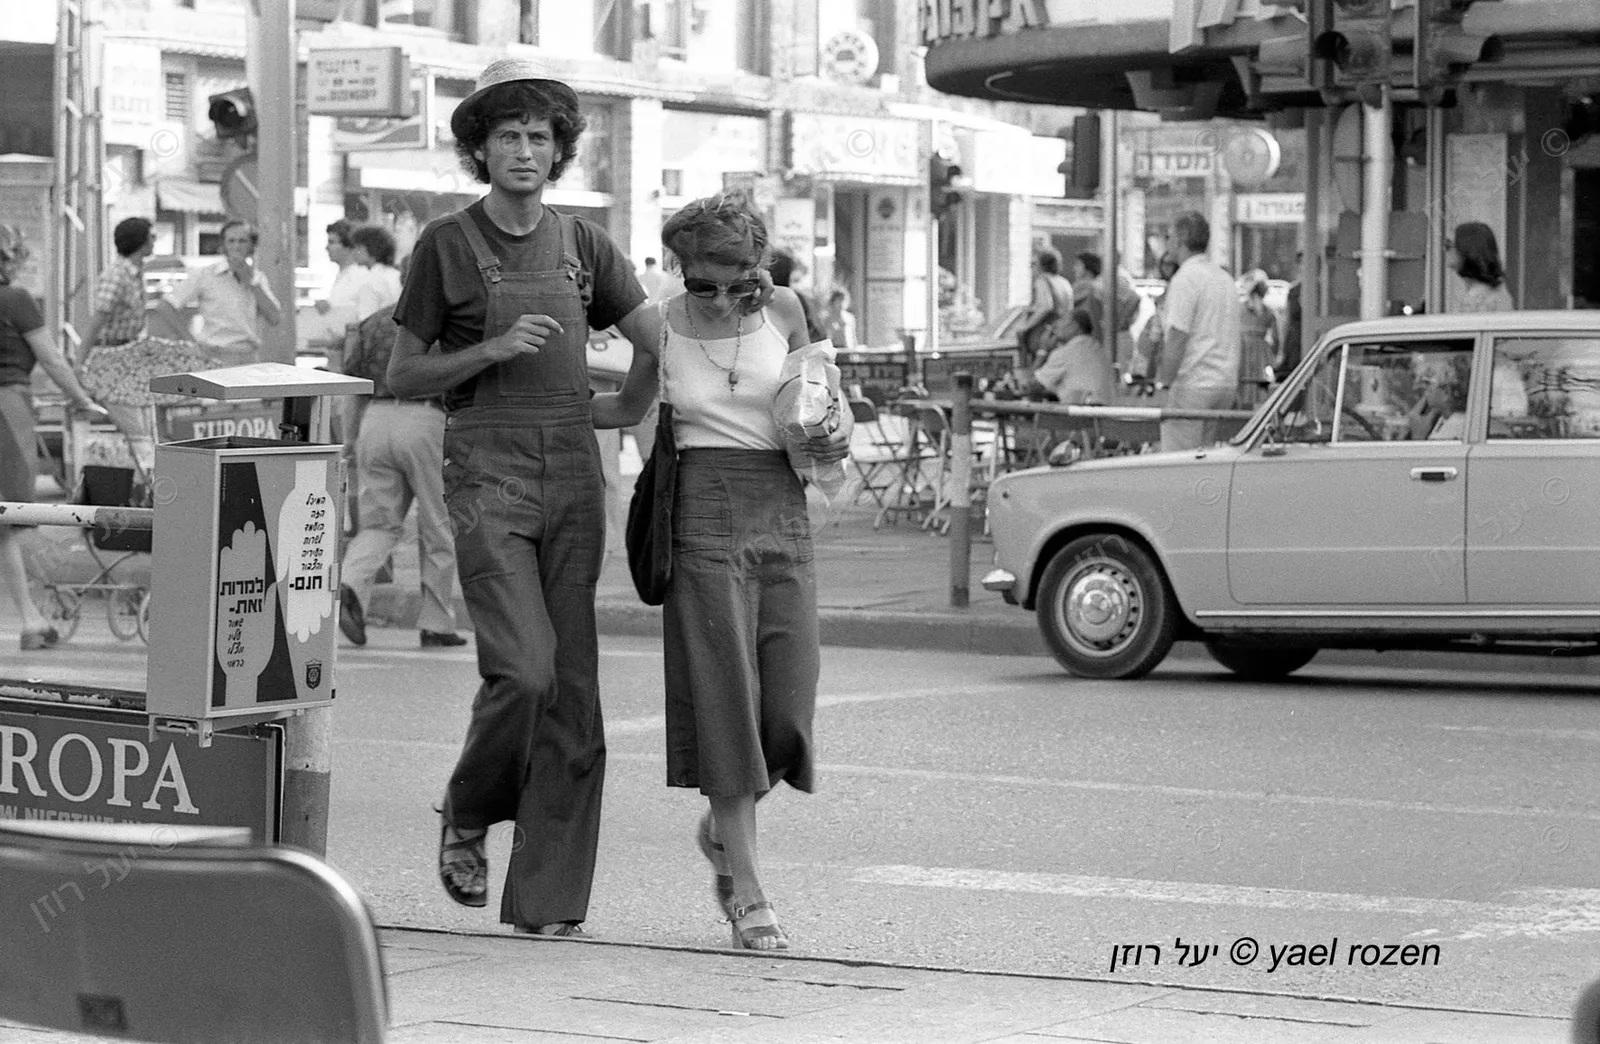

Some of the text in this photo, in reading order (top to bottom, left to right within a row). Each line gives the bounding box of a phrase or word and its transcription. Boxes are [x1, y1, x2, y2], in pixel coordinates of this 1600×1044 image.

[193, 416, 277, 440] EUROPA
[311, 509, 325, 518] הזה
[220, 577, 264, 596] למרות
